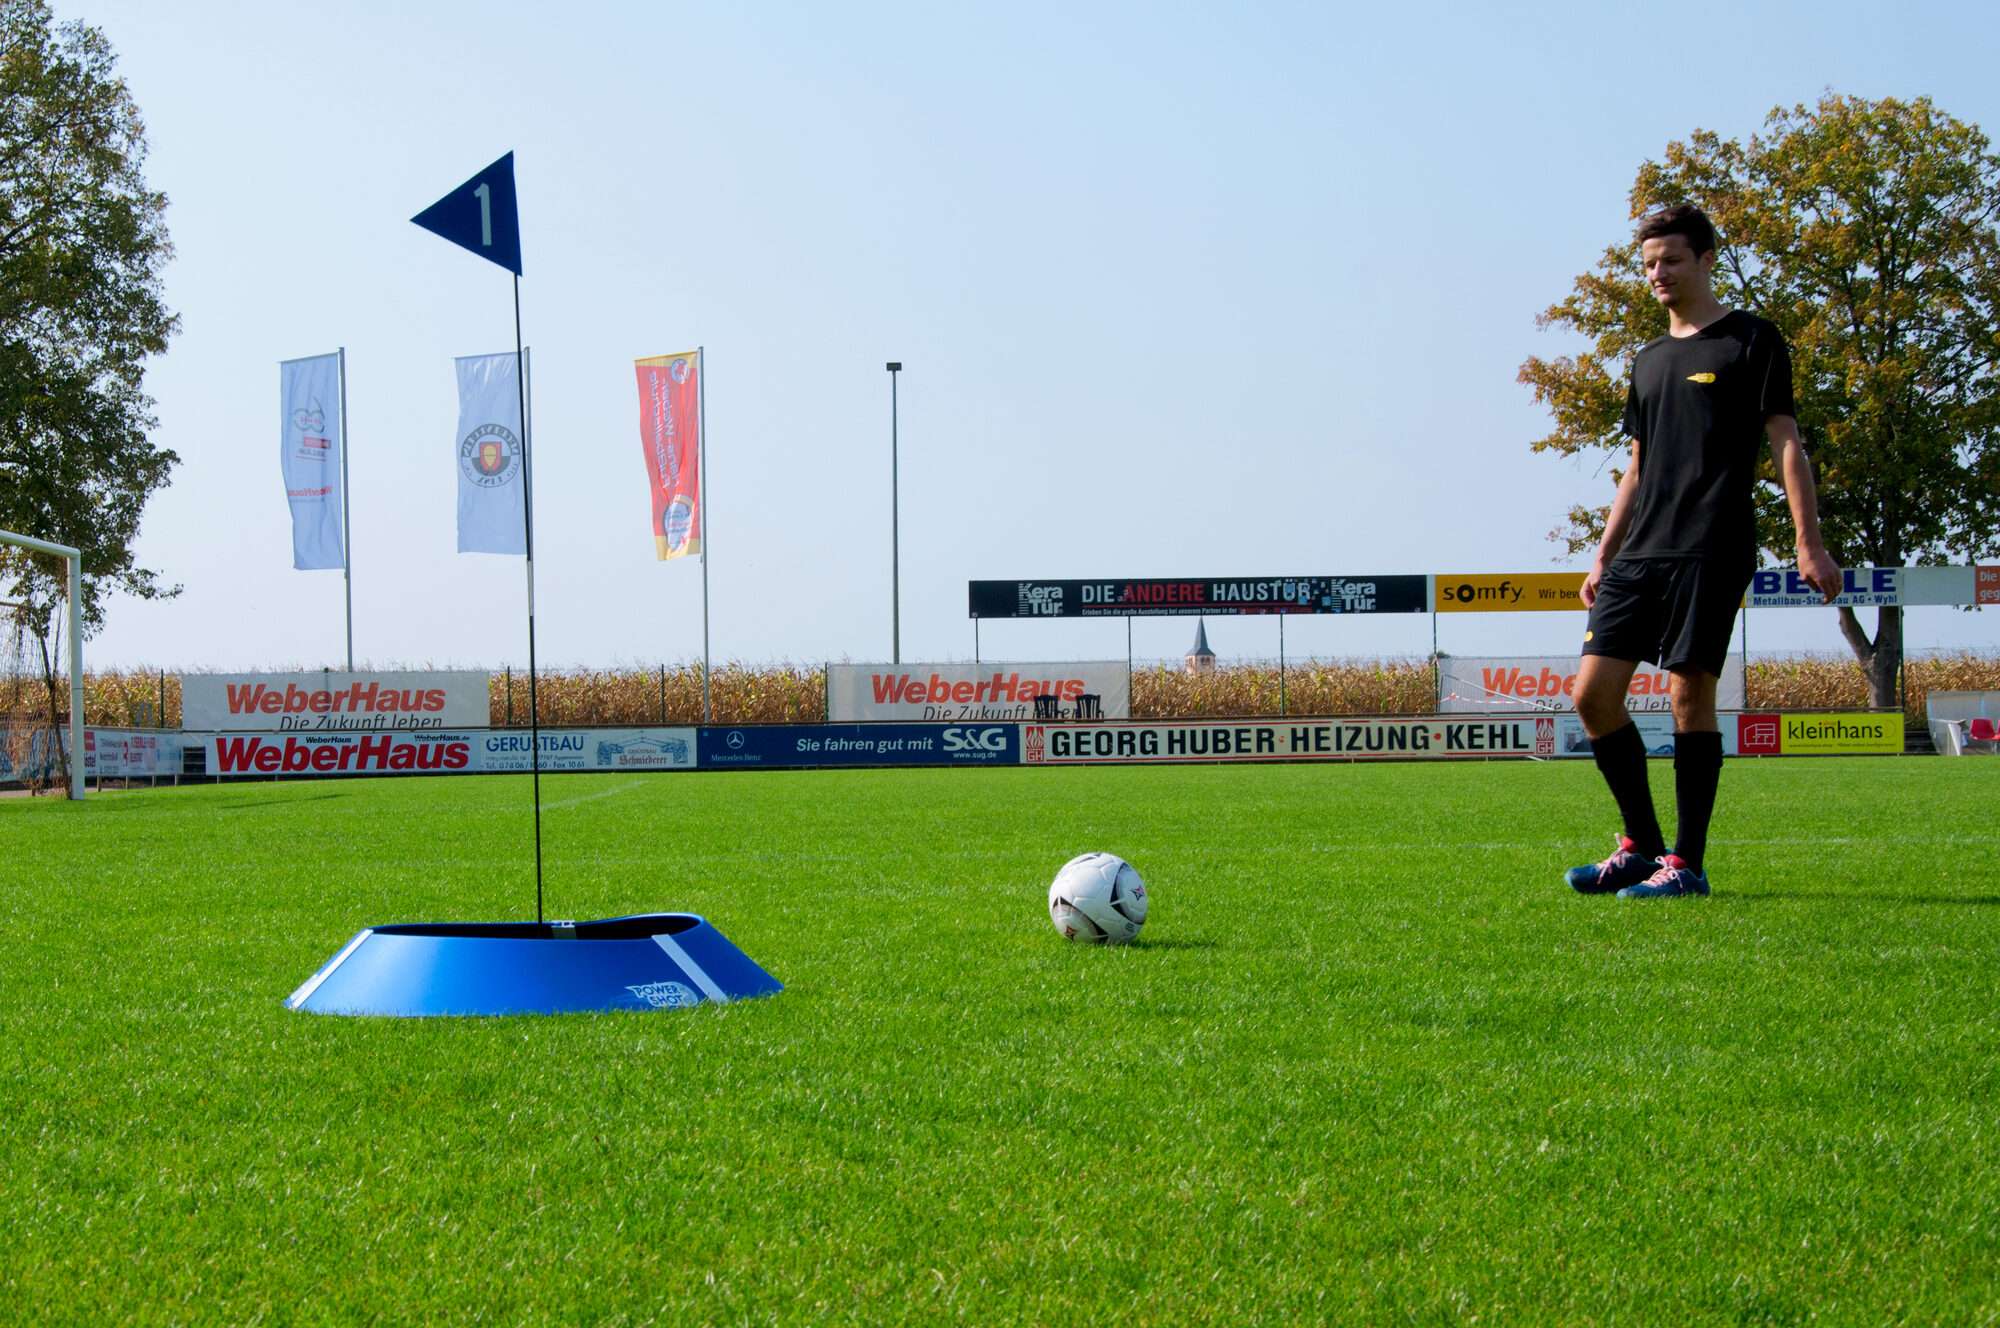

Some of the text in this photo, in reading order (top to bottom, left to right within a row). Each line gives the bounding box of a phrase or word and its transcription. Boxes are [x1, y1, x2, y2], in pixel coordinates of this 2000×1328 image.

[473, 182, 491, 246] 1
[1331, 579, 1376, 596] Kera
[1753, 569, 1896, 594] BELE
[1018, 583, 1063, 600] Kera
[1081, 584, 1115, 603] DIE
[1125, 582, 1205, 602] ANDERE
[1443, 581, 1523, 603] somfy
[1538, 588, 1555, 599] Wir
[1853, 595, 1865, 604] AG
[1874, 594, 1897, 605] Wyhl
[1028, 598, 1063, 615] Tür
[1342, 594, 1376, 611] Tür
[872, 672, 1085, 704] WeberHaus
[226, 682, 446, 714] WeberHaus
[924, 706, 951, 720] Die
[959, 704, 1026, 720] Zukunft
[280, 713, 442, 729] Die Zukunft leben
[1788, 720, 1883, 739] kleinhans
[796, 737, 933, 754] Sie fahren gut mit
[942, 727, 1007, 751] S&G
[1052, 724, 1529, 756] GEORG HUBER HEIZUNG KEHL
[216, 735, 469, 772] WeberHaus
[953, 751, 997, 760] www.sug.de
[637, 984, 681, 996] POWER
